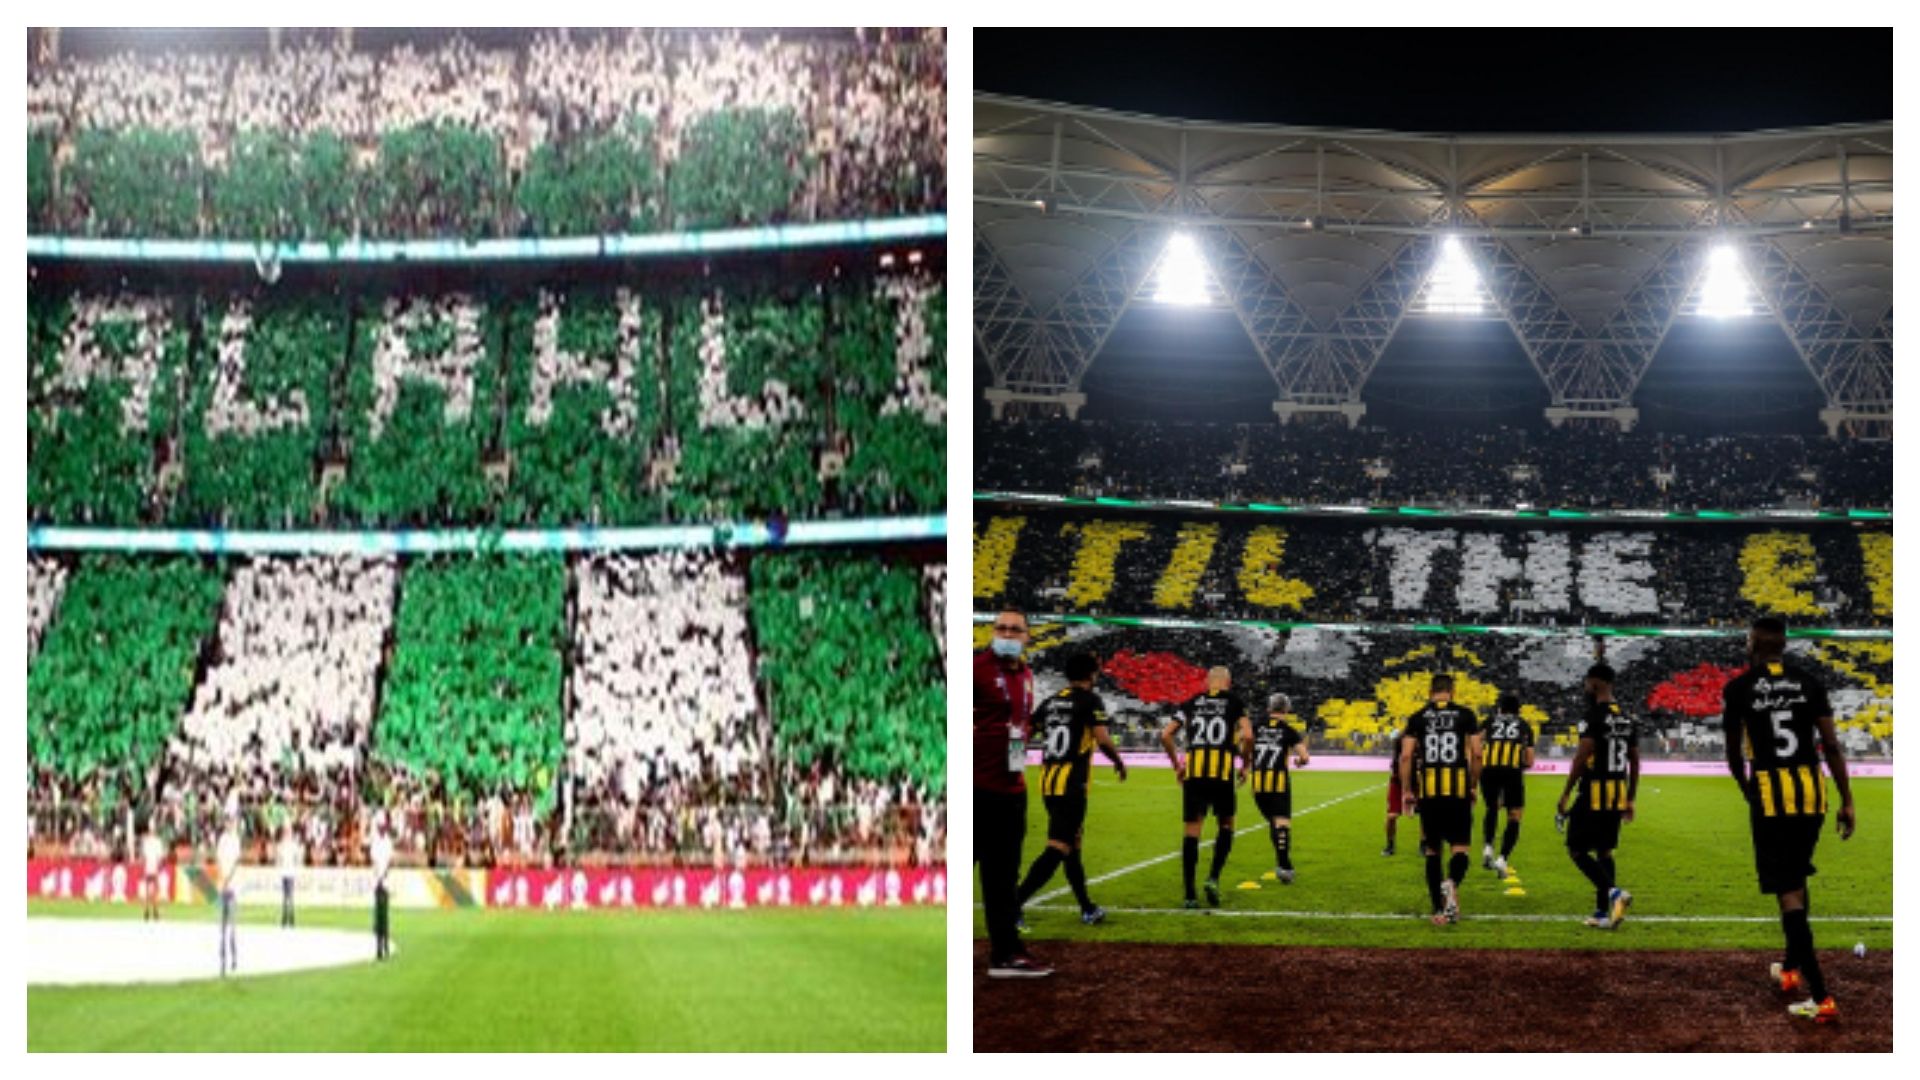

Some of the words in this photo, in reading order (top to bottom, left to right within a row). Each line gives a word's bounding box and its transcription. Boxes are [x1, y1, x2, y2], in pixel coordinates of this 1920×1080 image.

[1362, 526, 1659, 615] THE
[1191, 716, 1226, 745] 20
[1491, 721, 1519, 739] 26
[1770, 710, 1799, 757] 5
[1254, 743, 1282, 768] 77
[1425, 731, 1458, 763] 88
[1608, 738, 1628, 772] 13
